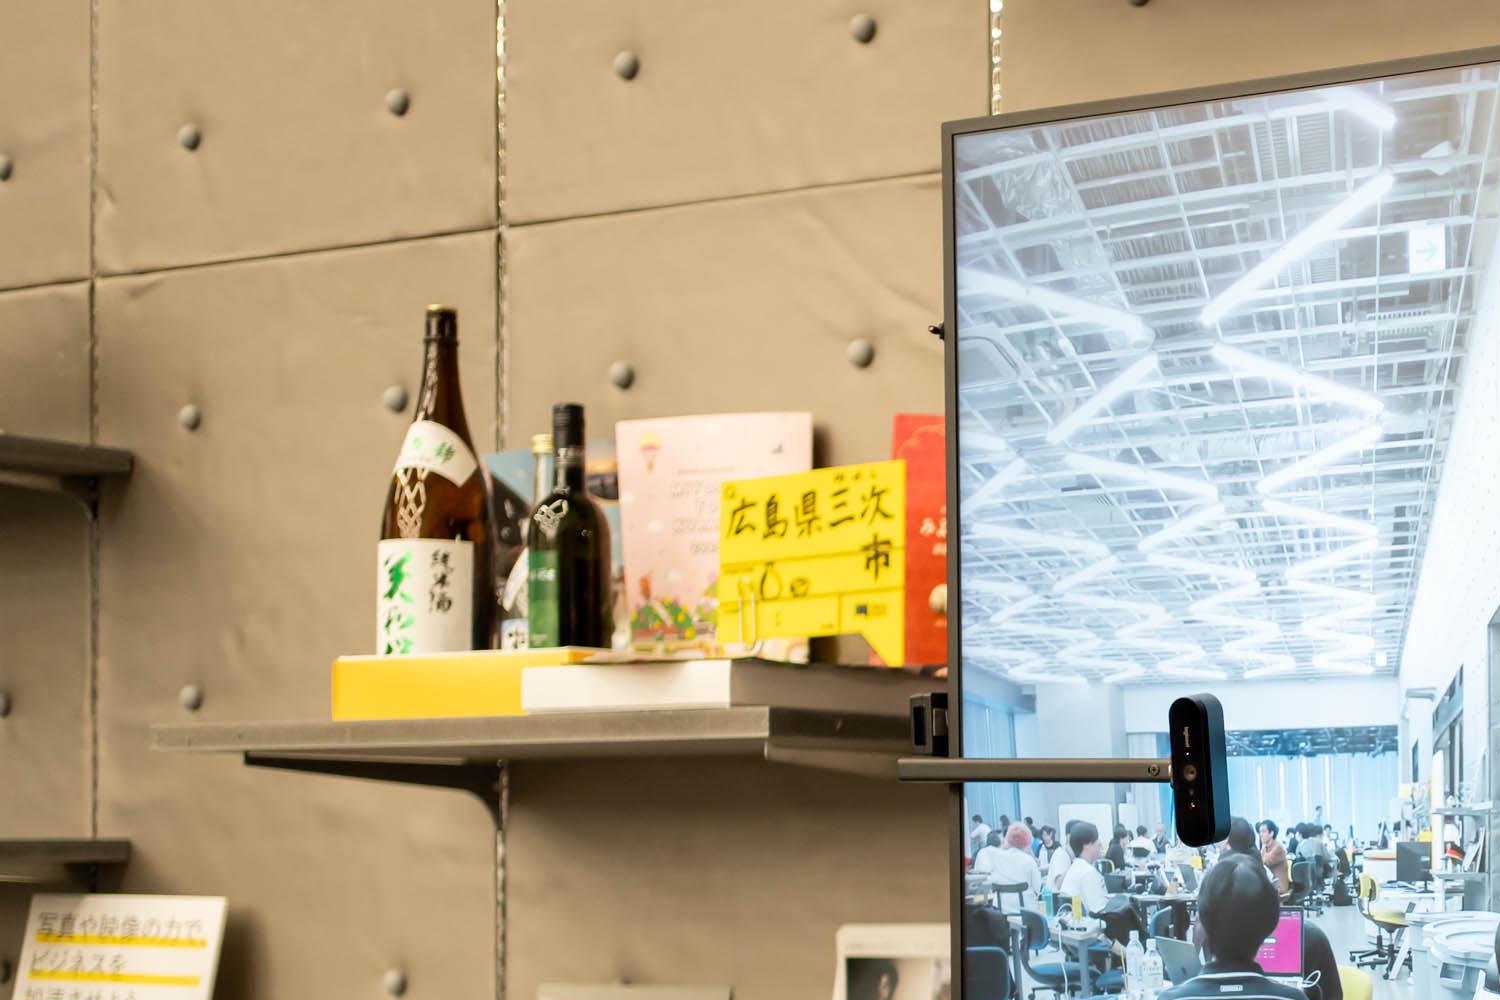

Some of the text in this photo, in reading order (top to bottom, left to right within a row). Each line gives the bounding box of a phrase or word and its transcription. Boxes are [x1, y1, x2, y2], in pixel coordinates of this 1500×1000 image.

[726, 484, 894, 540] 広島県三次
[862, 532, 893, 582] 市
